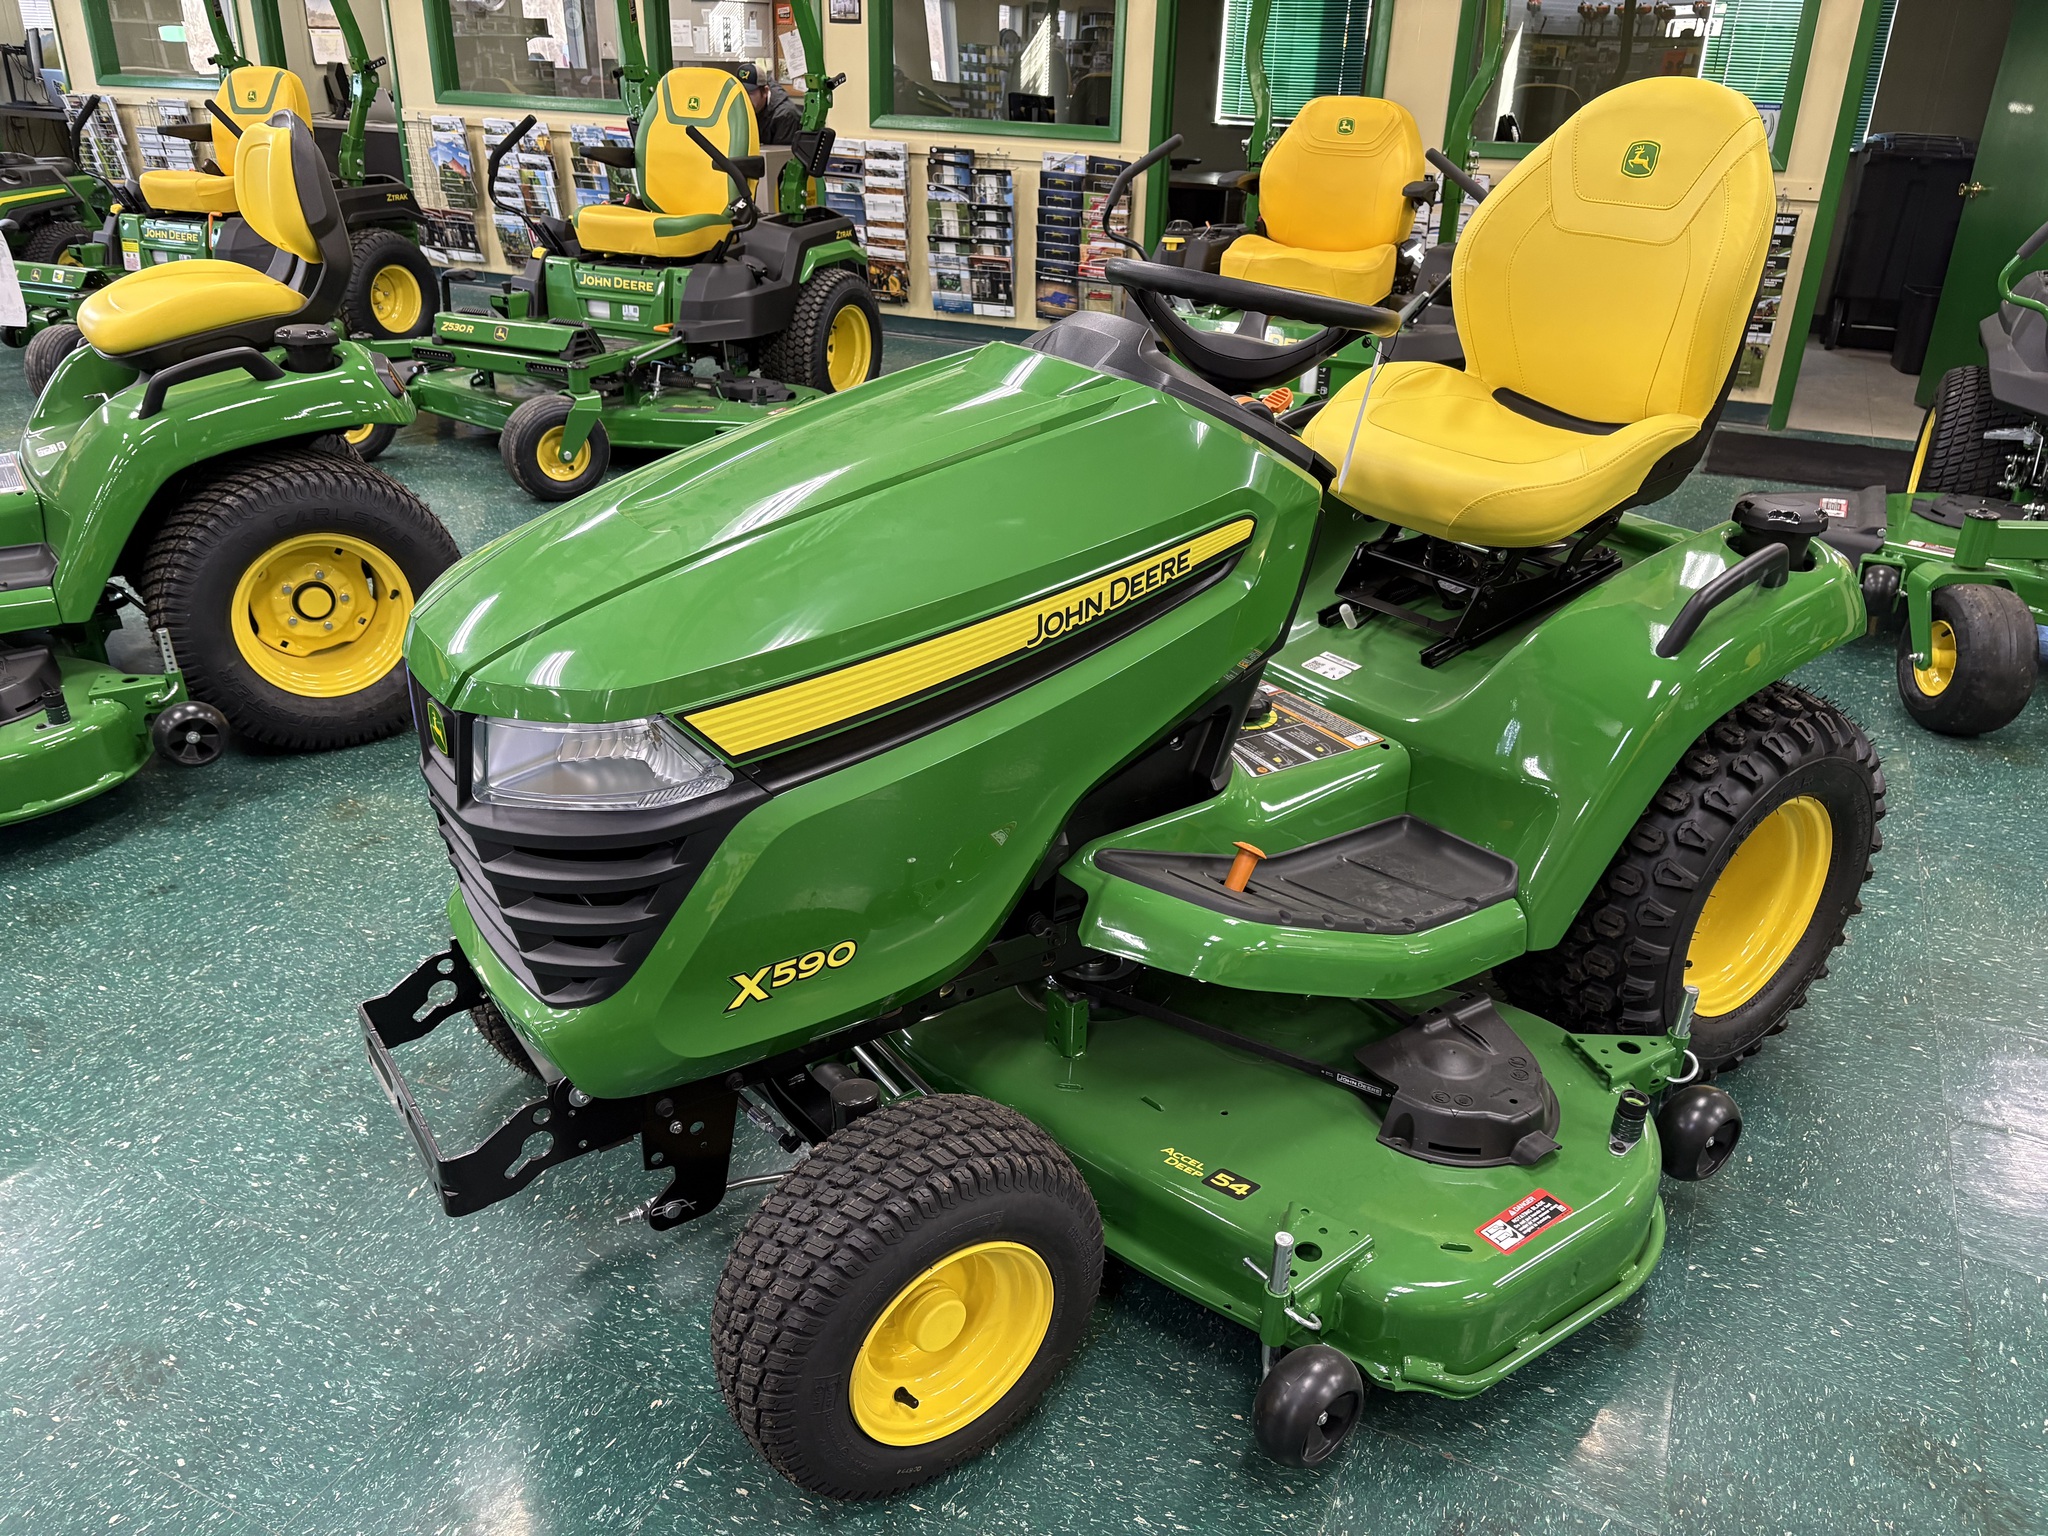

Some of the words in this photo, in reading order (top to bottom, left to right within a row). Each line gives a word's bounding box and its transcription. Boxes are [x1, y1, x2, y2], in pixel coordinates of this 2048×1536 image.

[386, 193, 409, 202] ZTRAK
[144, 227, 168, 239] JOHN
[168, 230, 199, 243] DEERE
[835, 229, 854, 240] ZTRAK
[580, 273, 612, 288] JOHN
[613, 277, 655, 292] DEERE
[1026, 591, 1103, 648] JOHN
[1109, 547, 1193, 610] DEERE
[723, 939, 858, 1013] X590
[1338, 1074, 1357, 1086] JOHN
[1357, 1082, 1381, 1094] DEERE
[1160, 1147, 1205, 1170] ACCEL
[1163, 1156, 1204, 1178] DEEP
[1210, 1172, 1251, 1196] 54
[1513, 1196, 1537, 1213] DANGER
